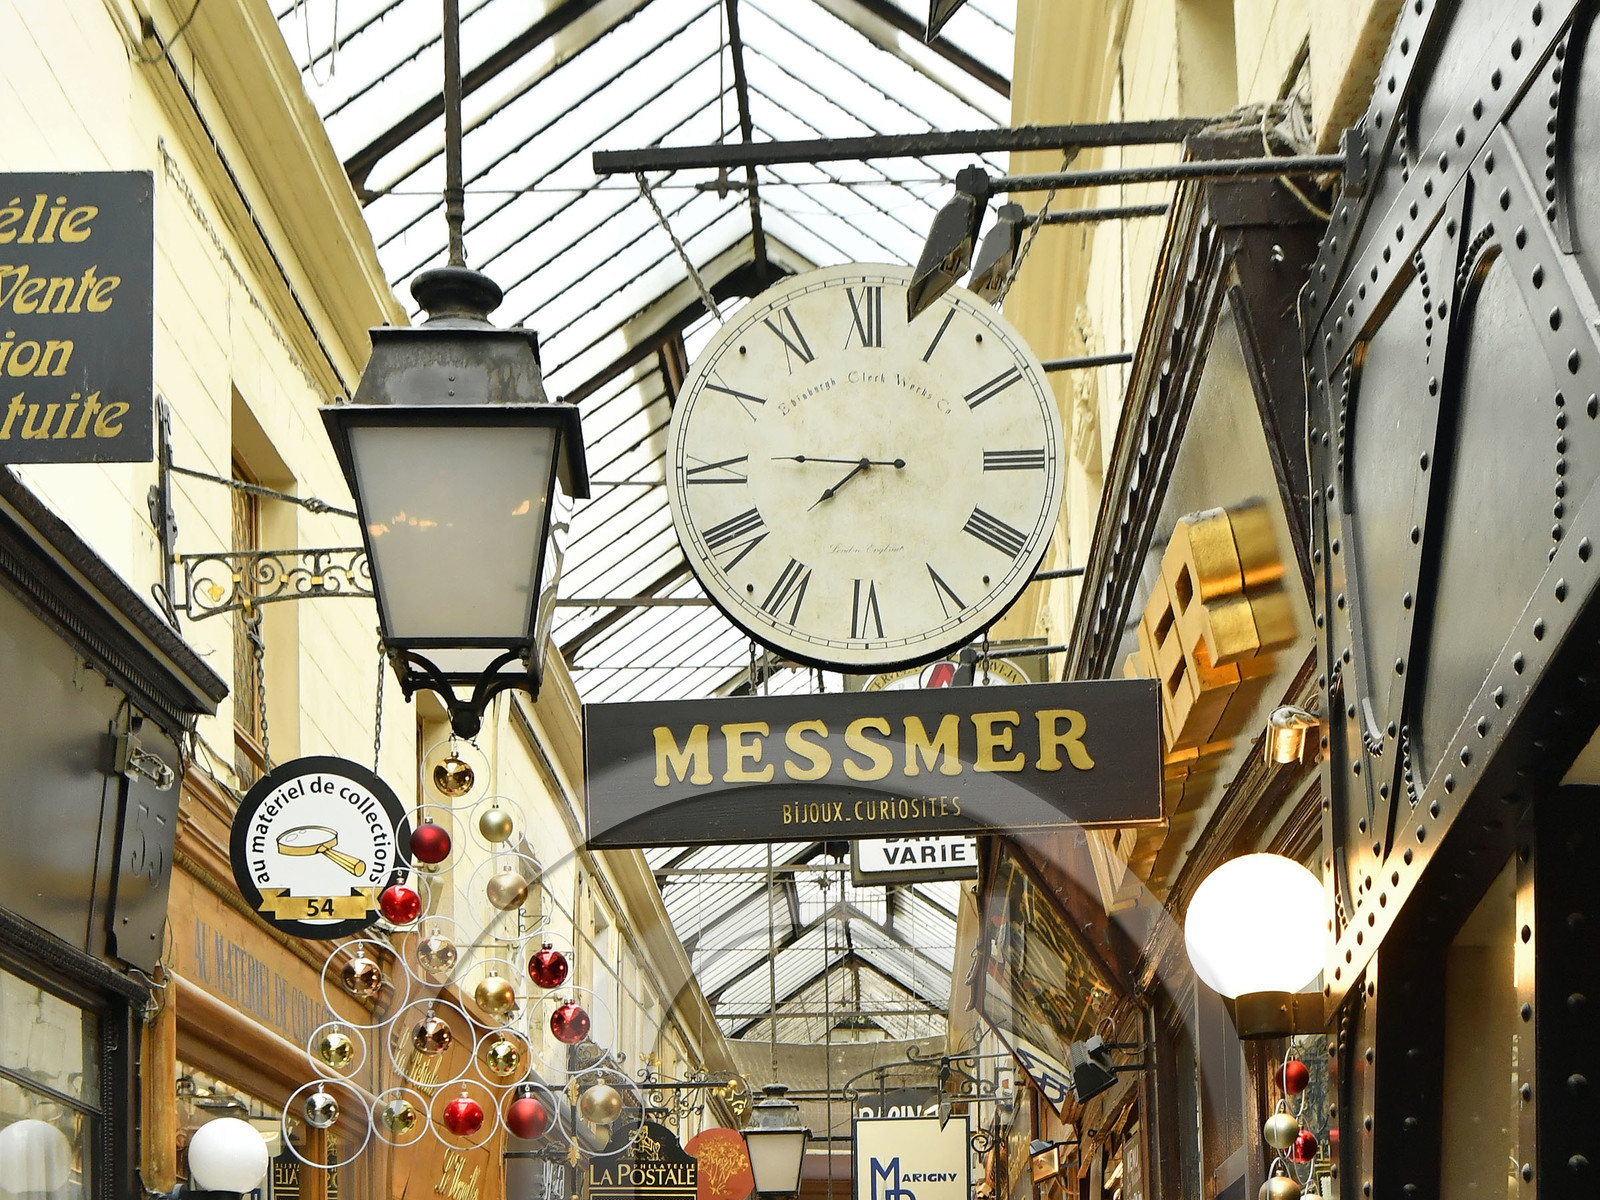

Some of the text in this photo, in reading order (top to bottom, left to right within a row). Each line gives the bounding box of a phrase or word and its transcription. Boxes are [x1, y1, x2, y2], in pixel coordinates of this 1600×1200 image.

[652, 709, 1096, 787] MESSMER
[251, 775, 392, 884] au matériel de collections
[306, 898, 335, 917] 54
[590, 1163, 696, 1186] LA POSTALE
